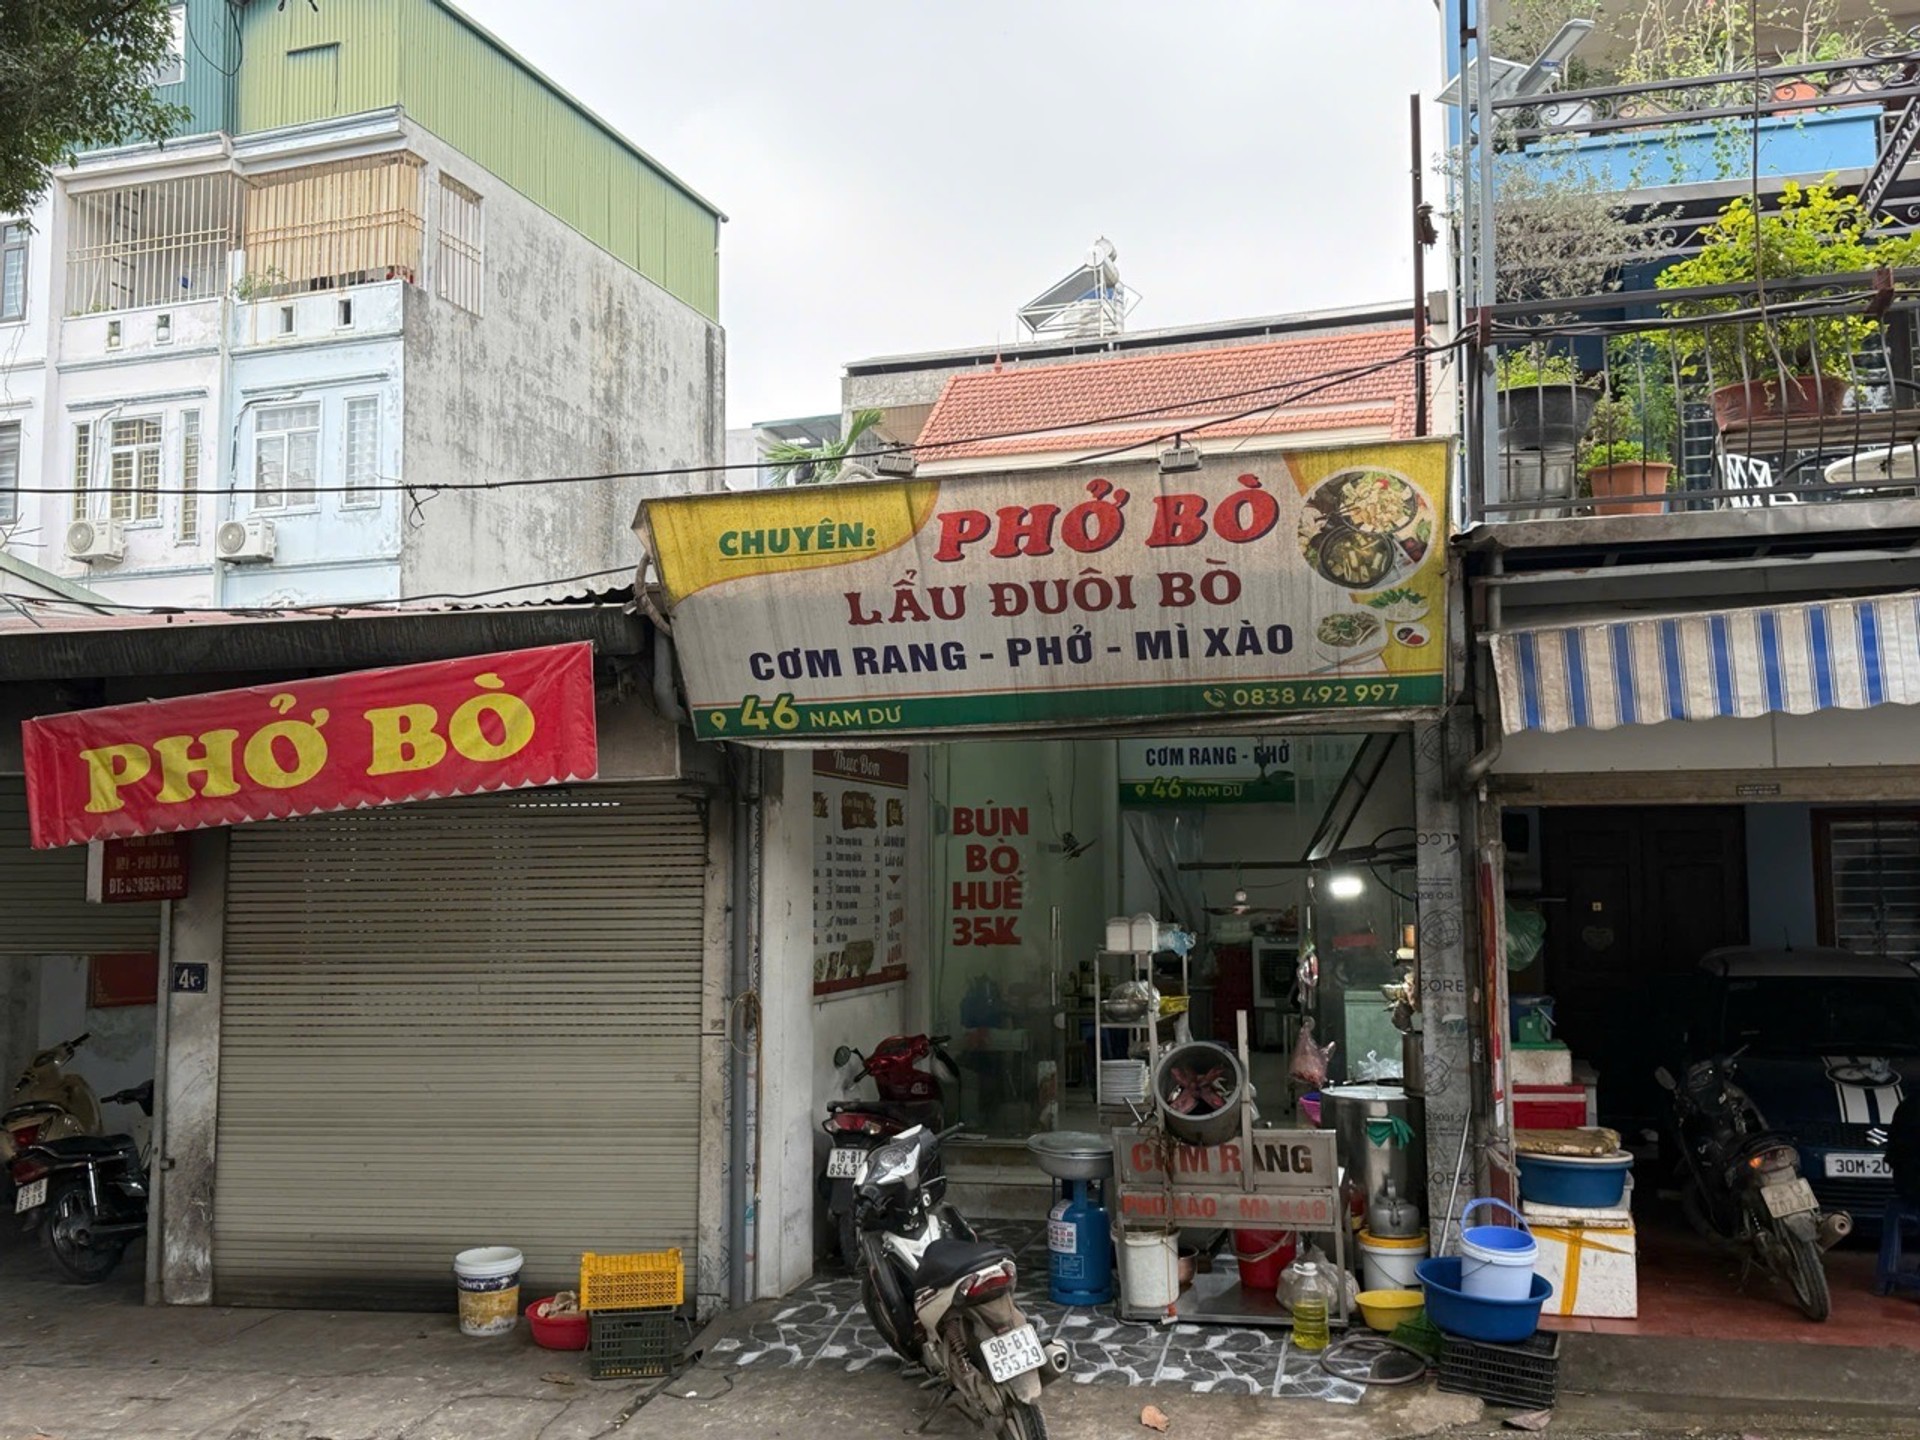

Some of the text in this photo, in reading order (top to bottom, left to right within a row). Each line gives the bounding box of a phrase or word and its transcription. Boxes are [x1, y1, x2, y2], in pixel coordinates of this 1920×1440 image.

[718, 517, 877, 556] CHUYÊN:
[933, 473, 1280, 564] PHỞ BÒ
[844, 558, 1242, 626] LẨU ĐUÔI BÒ
[749, 647, 842, 681] CƠM
[852, 641, 967, 675] RANG
[1006, 624, 1093, 667] PHỞ
[1135, 622, 1190, 661] MÌ
[1203, 619, 1294, 658] XÀO
[739, 693, 901, 732] 46 NAM DƯ
[1233, 683, 1400, 706] 0838 492 997
[79, 672, 536, 814] PHỞ BÒ
[1146, 746, 1184, 766] CƠM
[1189, 746, 1236, 765] RANG
[1152, 776, 1183, 799] 46
[1187, 785, 1220, 797] NAM
[953, 799, 1029, 836] BÚN
[966, 838, 1020, 875] BÒ
[952, 870, 1025, 910] HUẾ
[952, 916, 1022, 947] 35K
[990, 1330, 1031, 1358] 98-B1
[993, 1345, 1041, 1378] 555.29
